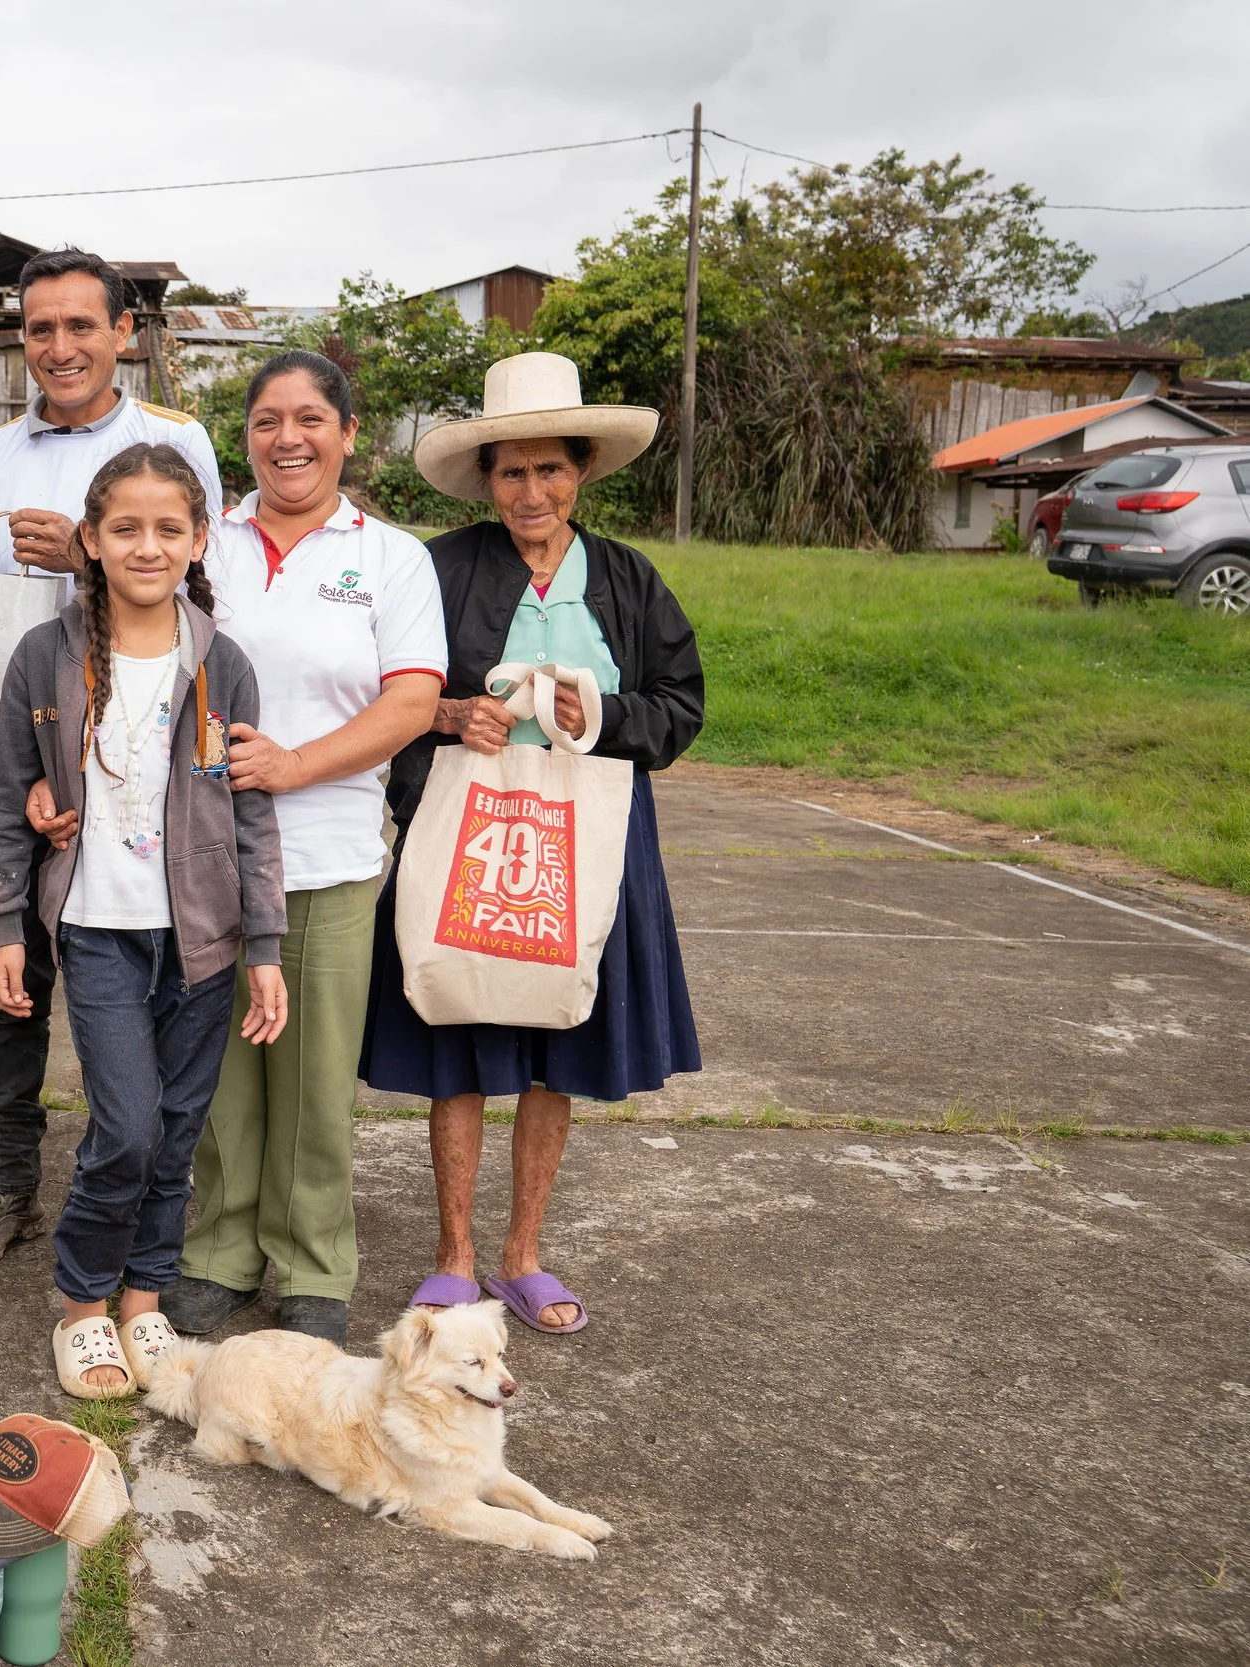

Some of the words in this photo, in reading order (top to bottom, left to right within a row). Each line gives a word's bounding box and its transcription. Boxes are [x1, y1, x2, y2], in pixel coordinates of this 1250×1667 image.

[493, 798, 520, 819] EQUAL
[521, 798, 566, 828] EXCANGE
[464, 821, 537, 895] 40
[443, 927, 570, 960] ANNIVERSARY
[0, 1438, 29, 1463] ITHACA
